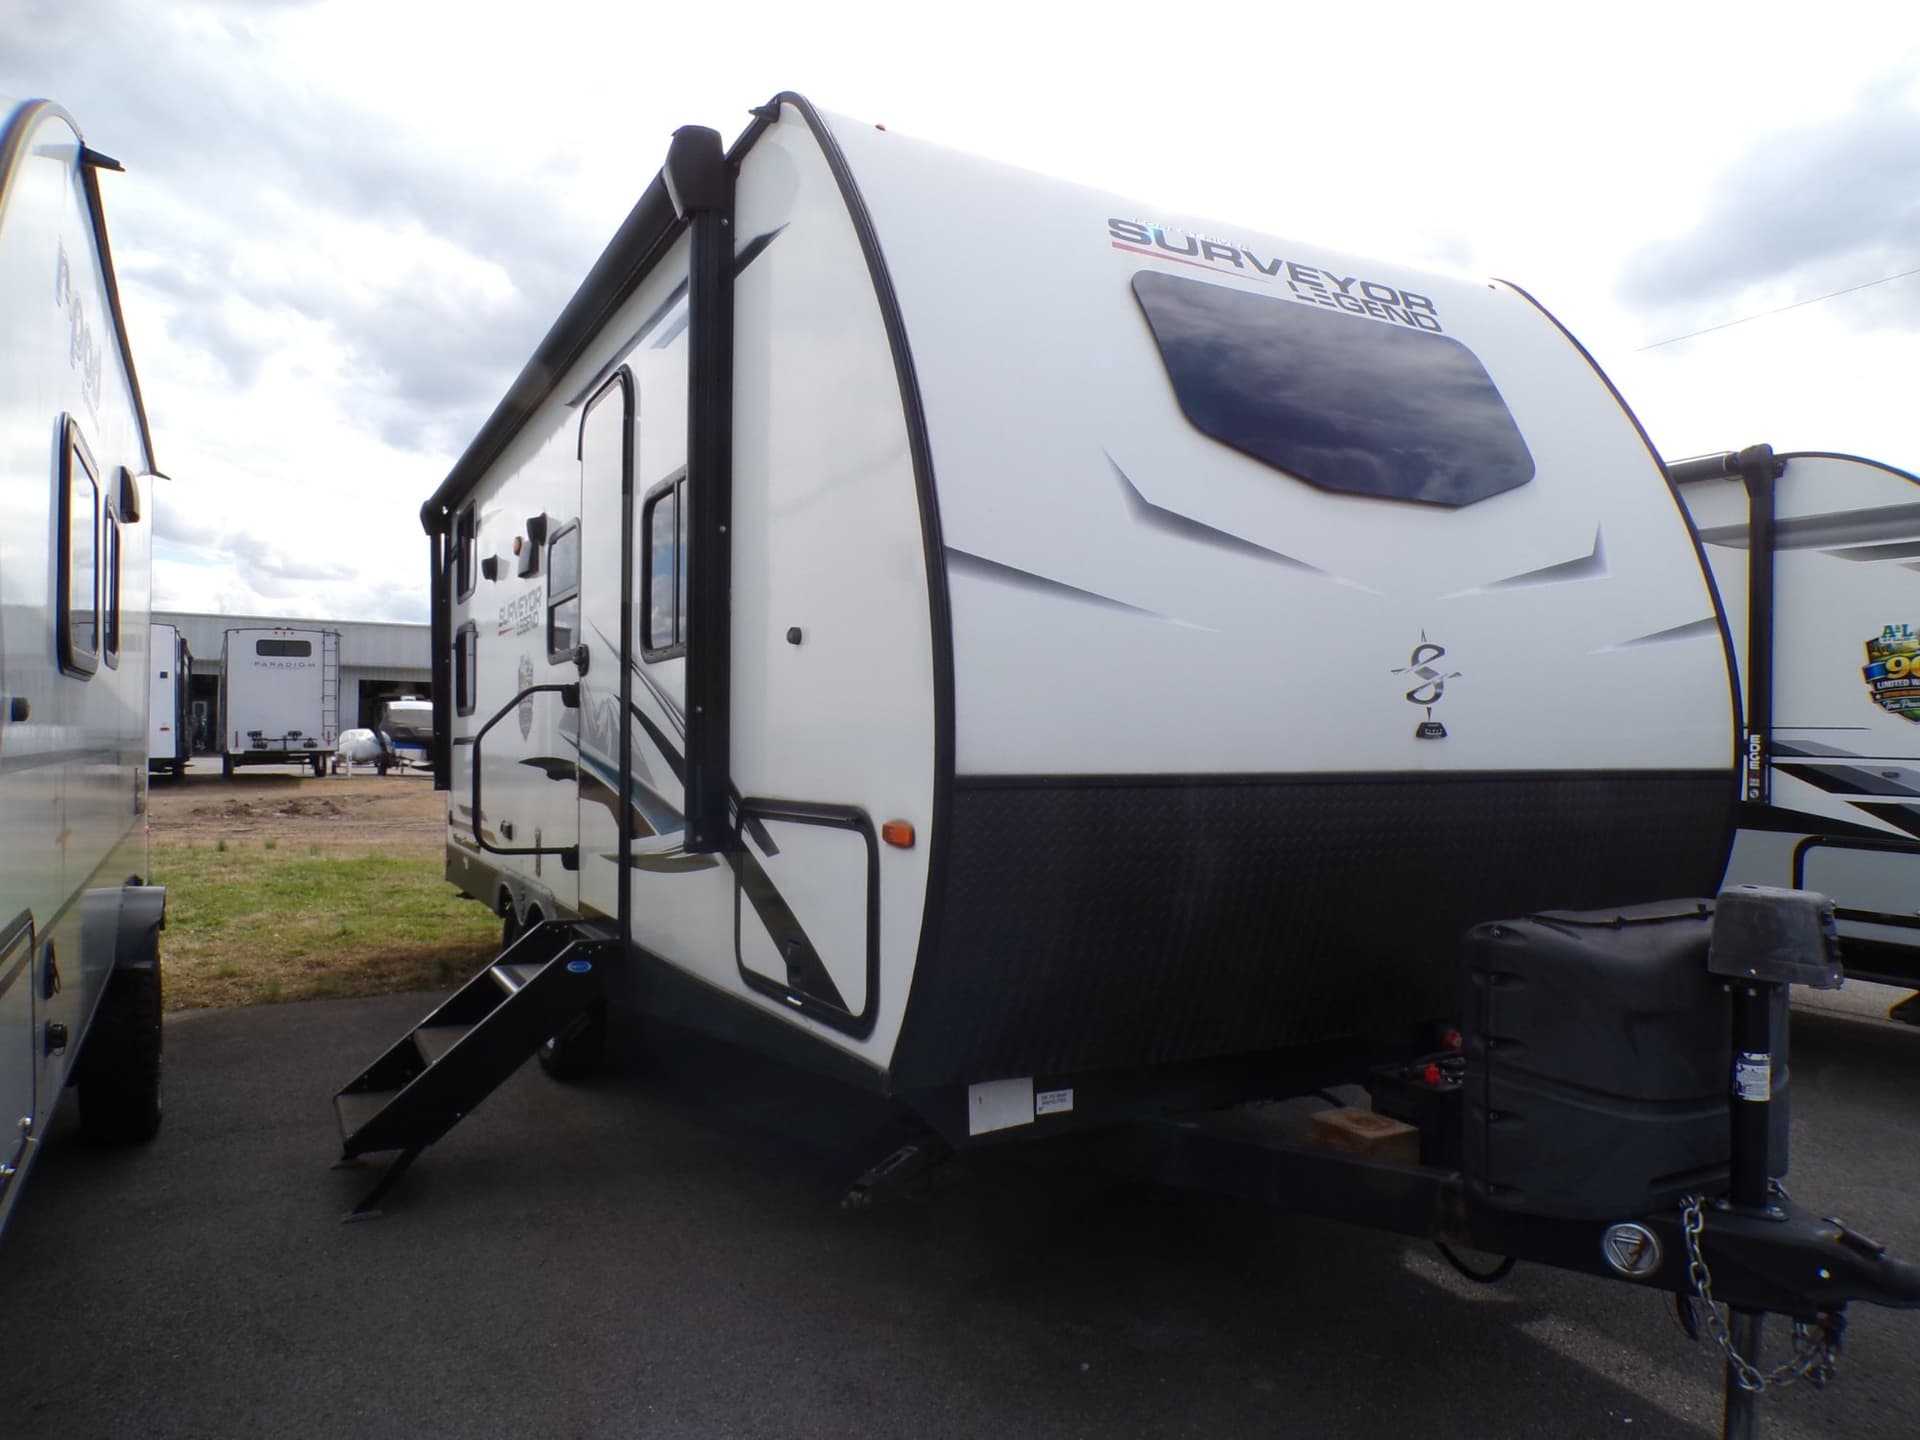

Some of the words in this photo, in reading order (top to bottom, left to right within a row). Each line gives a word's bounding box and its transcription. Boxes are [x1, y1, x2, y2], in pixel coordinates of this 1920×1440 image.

[1107, 218, 1438, 316] SURVEYOR
[1286, 280, 1443, 333] LEGEND
[498, 586, 542, 627] SURVEYOR
[1876, 679, 1909, 689] LIMITED
